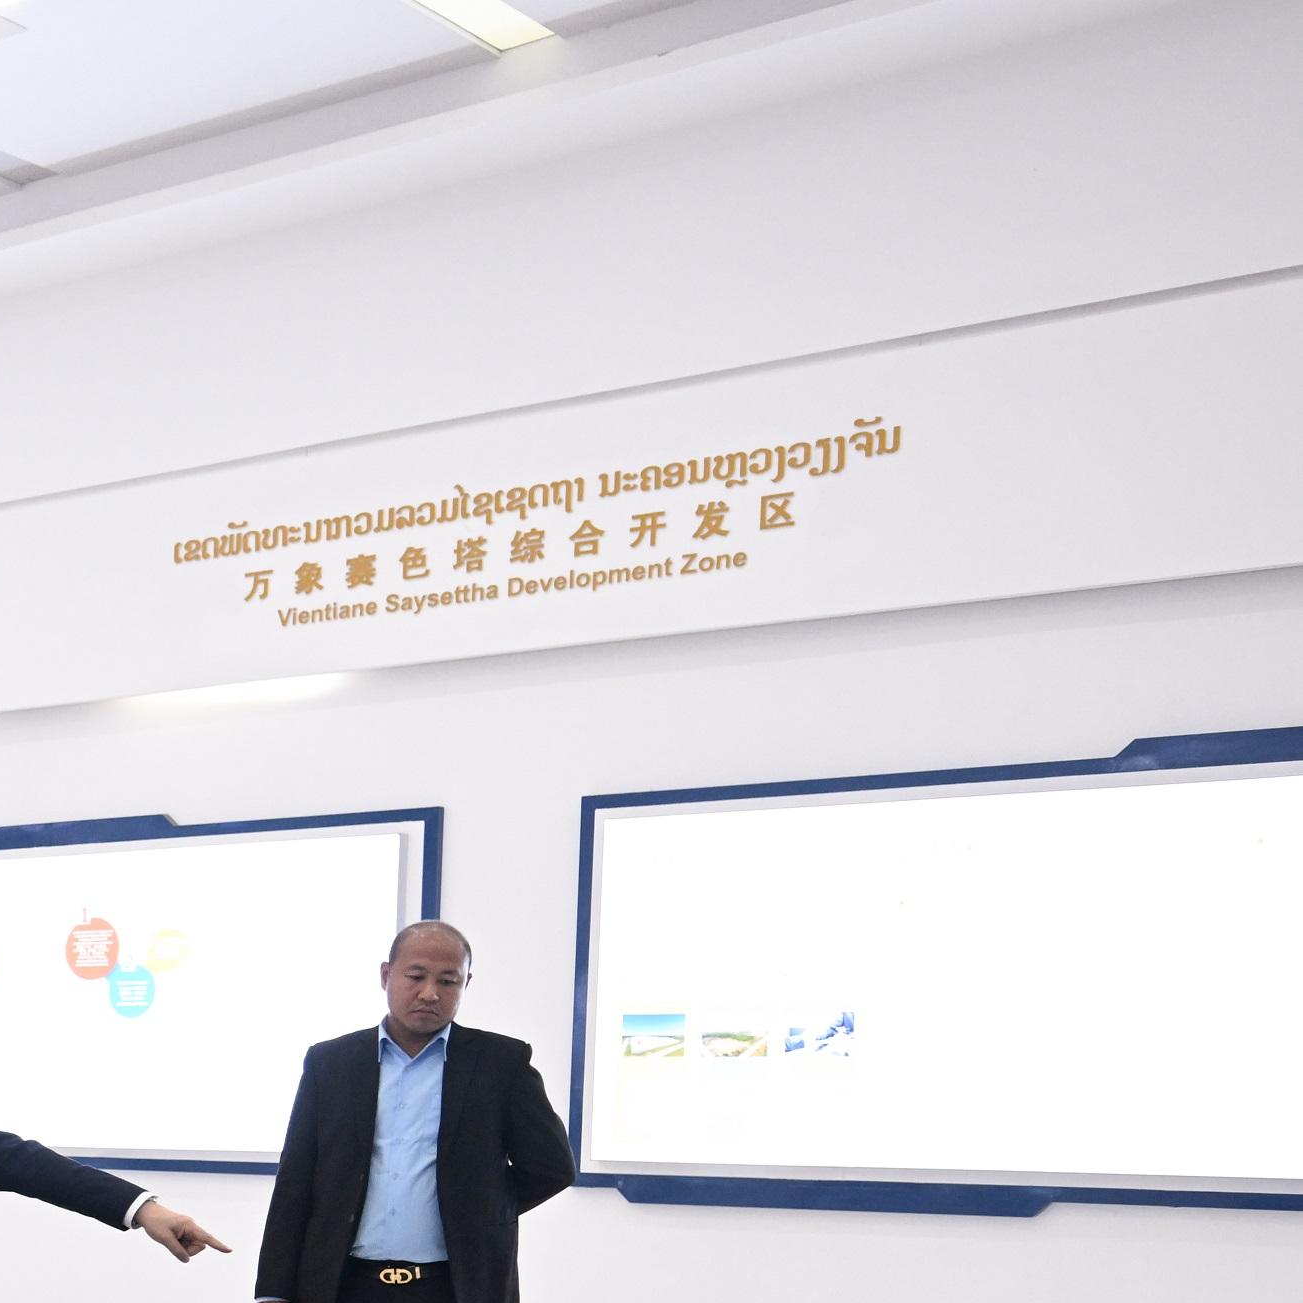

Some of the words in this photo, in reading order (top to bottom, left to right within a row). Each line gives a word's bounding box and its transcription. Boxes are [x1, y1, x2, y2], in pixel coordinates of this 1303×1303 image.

[244, 492, 796, 601] 万象赛色塔综合开发区
[277, 599, 378, 627] Vientiane
[385, 582, 499, 616] Saysettha
[508, 560, 674, 598] Development
[680, 550, 749, 575] Zone
